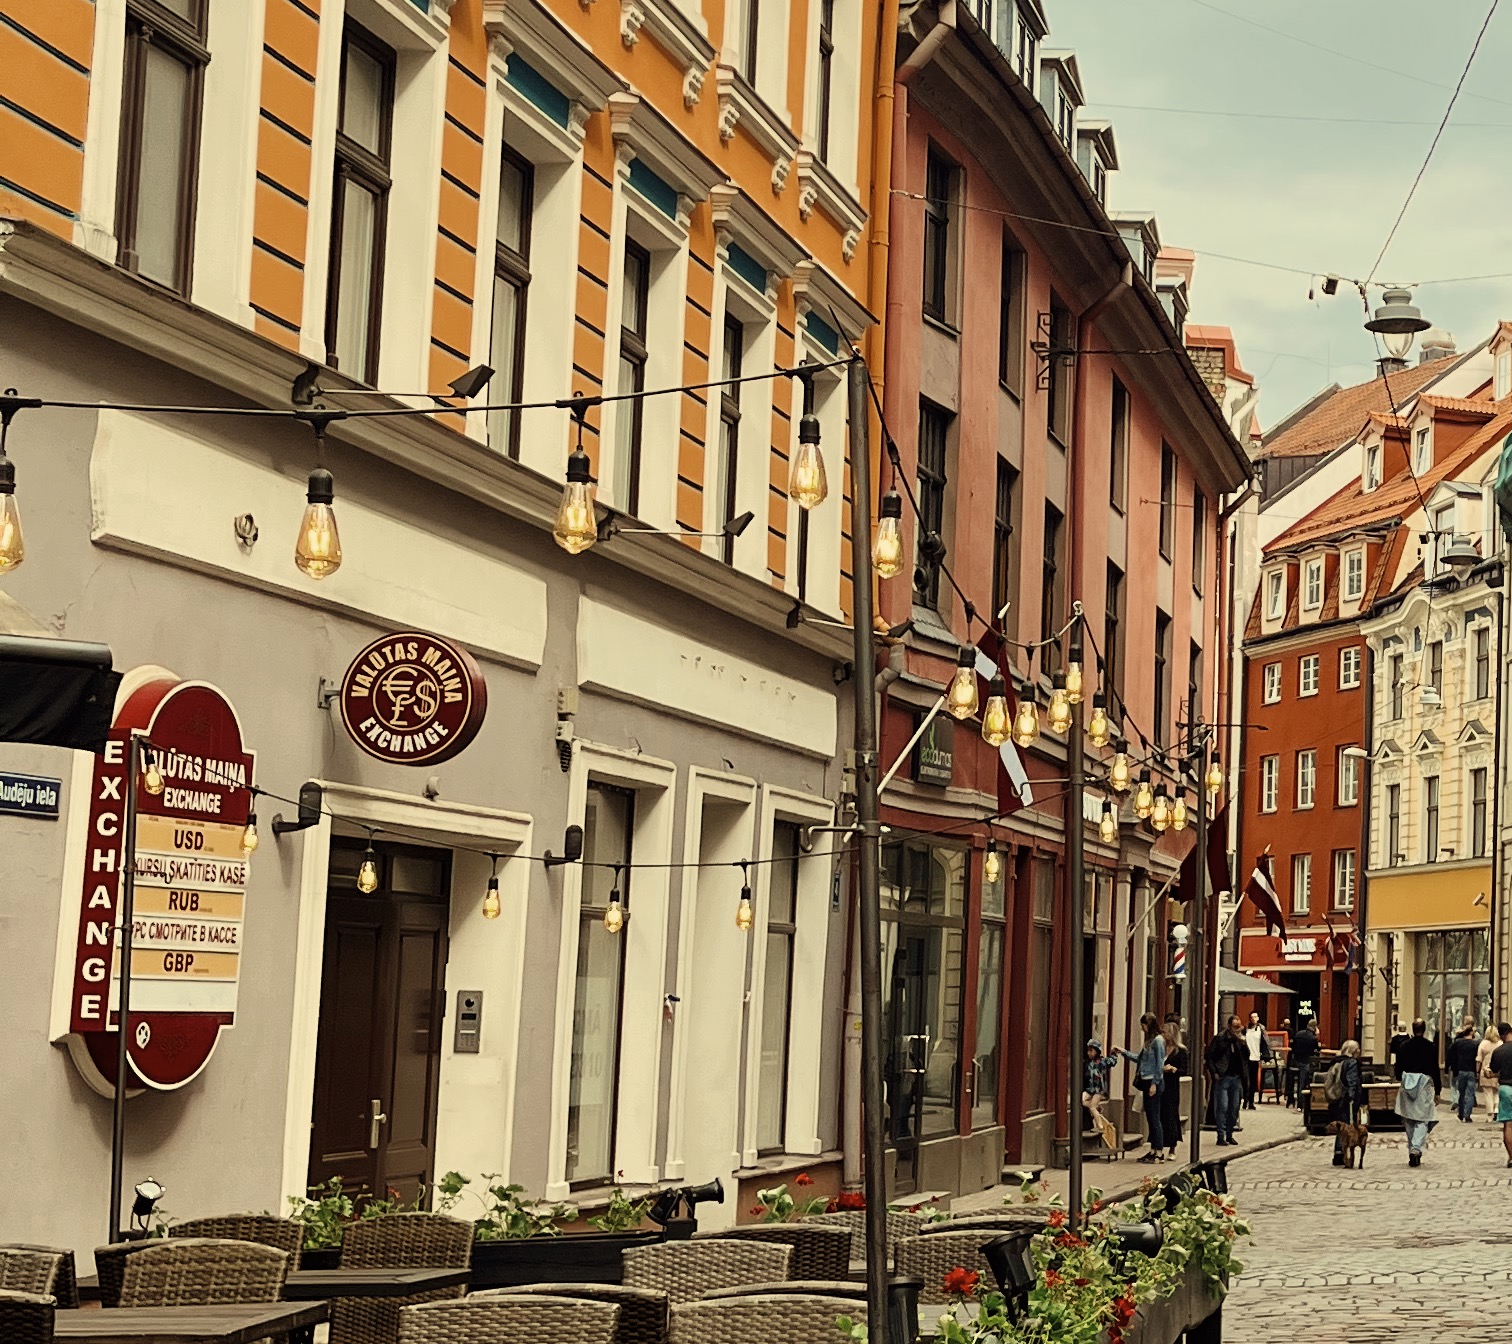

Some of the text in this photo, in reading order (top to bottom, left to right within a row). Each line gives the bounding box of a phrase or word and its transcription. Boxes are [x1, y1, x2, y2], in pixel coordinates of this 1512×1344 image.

[359, 716, 449, 753] EXCHANGE
[36, 784, 56, 806] iela
[163, 787, 221, 814] EXCHANGE
[174, 829, 204, 850] USD
[80, 740, 125, 1019] EXCHANGE
[168, 890, 200, 912] RUB
[207, 926, 237, 944] КАССЕ
[163, 952, 194, 973] GBP
